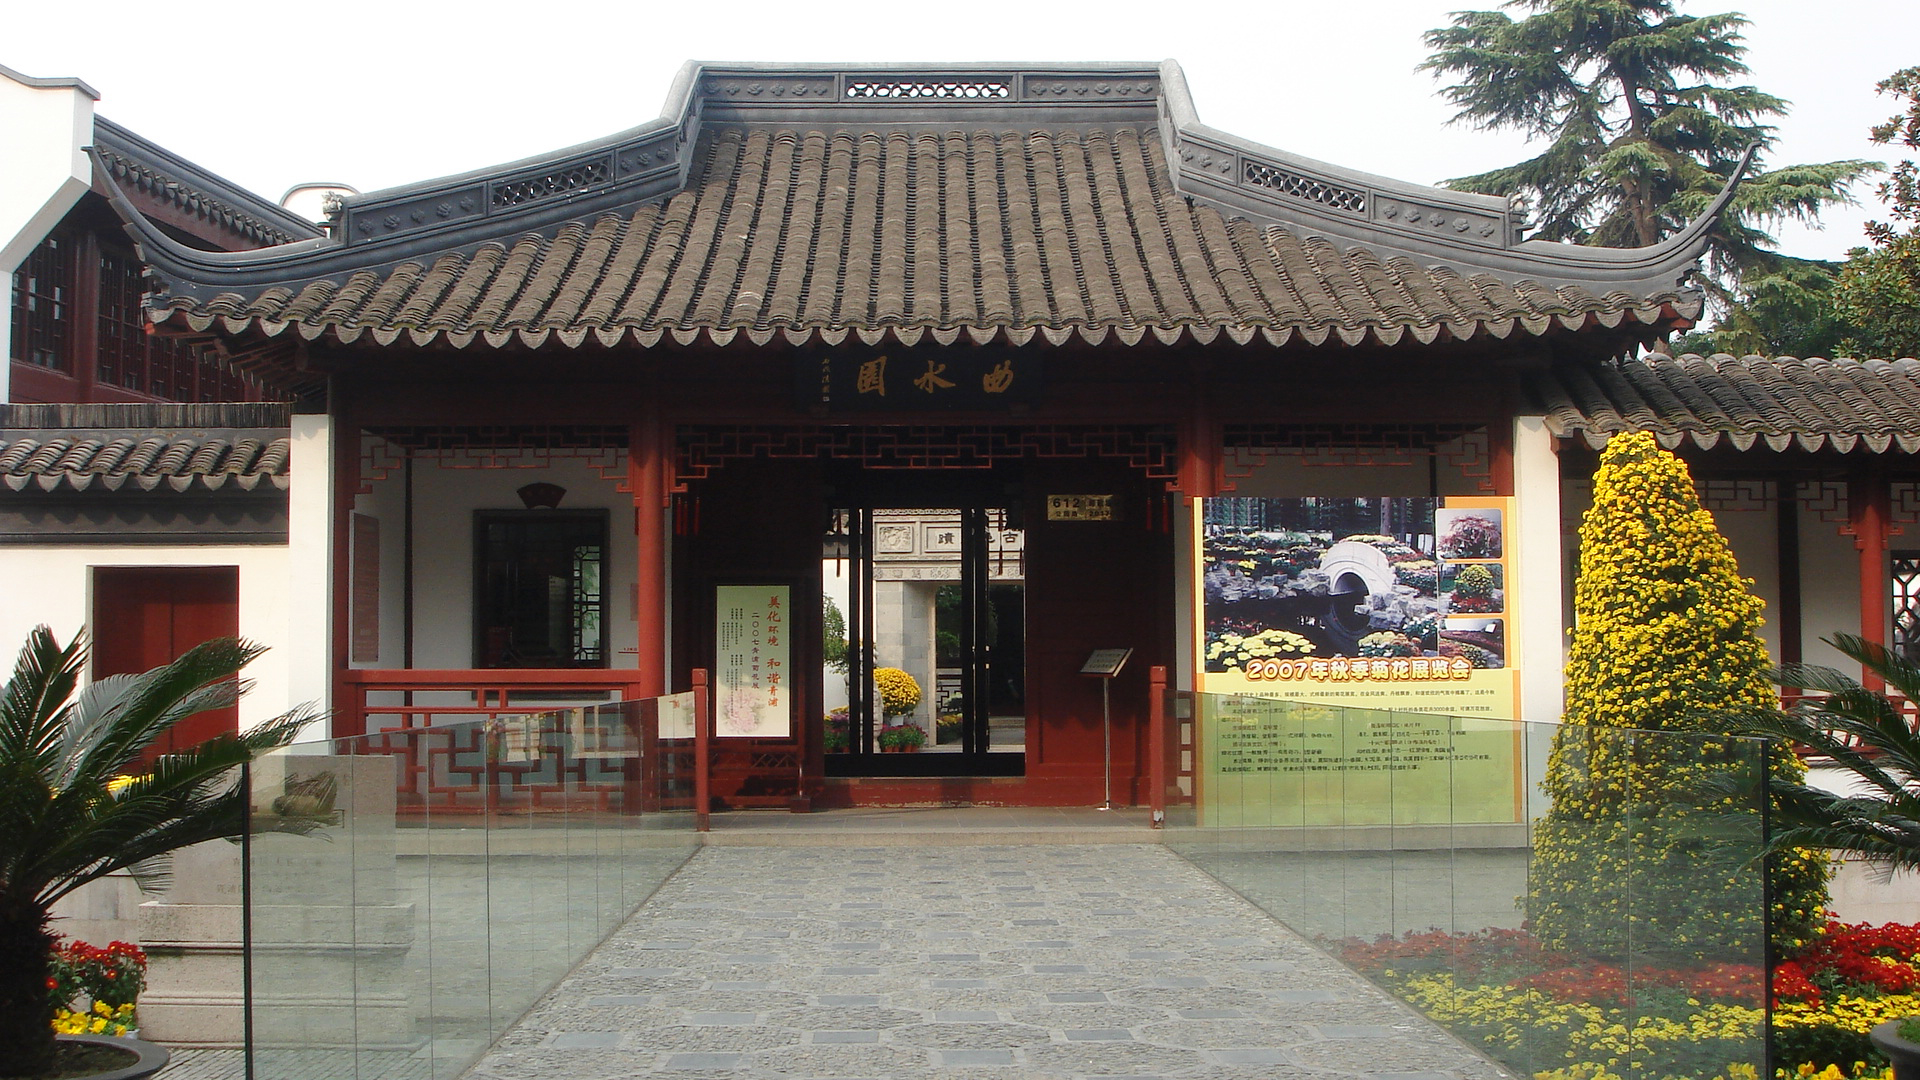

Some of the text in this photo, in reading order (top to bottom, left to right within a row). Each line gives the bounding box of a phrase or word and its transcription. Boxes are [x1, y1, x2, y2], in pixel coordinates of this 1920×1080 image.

[1053, 498, 1080, 508] 612
[767, 595, 782, 707] 美化环境 和谐青浦
[1247, 657, 1472, 682] 2007年秋季菊花展览会
